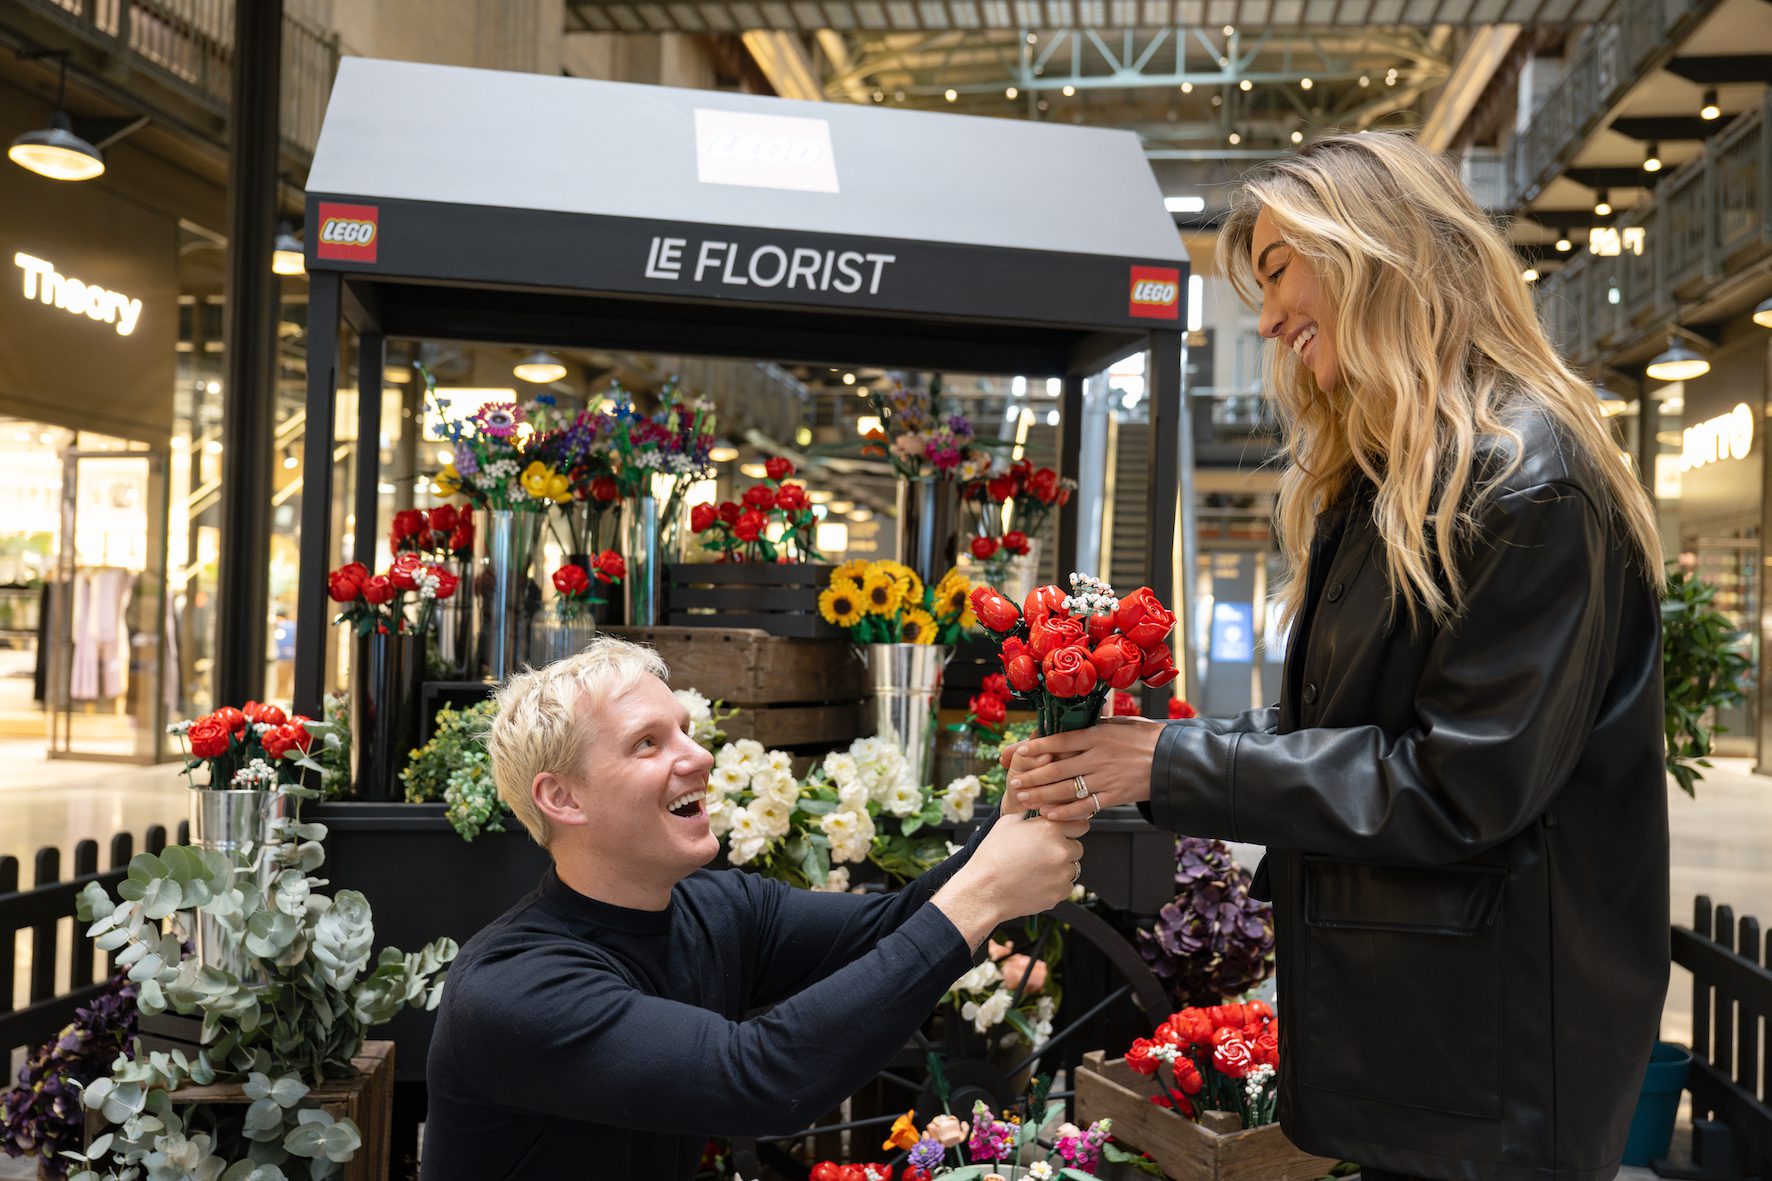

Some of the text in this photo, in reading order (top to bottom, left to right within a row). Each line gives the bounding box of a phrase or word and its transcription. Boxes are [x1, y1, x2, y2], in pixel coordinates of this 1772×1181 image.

[708, 130, 821, 164] LEGO
[321, 219, 374, 245] LEGO
[645, 236, 896, 295] LE FLORIST
[14, 252, 142, 336] Theory
[1132, 281, 1177, 304] LEGO
